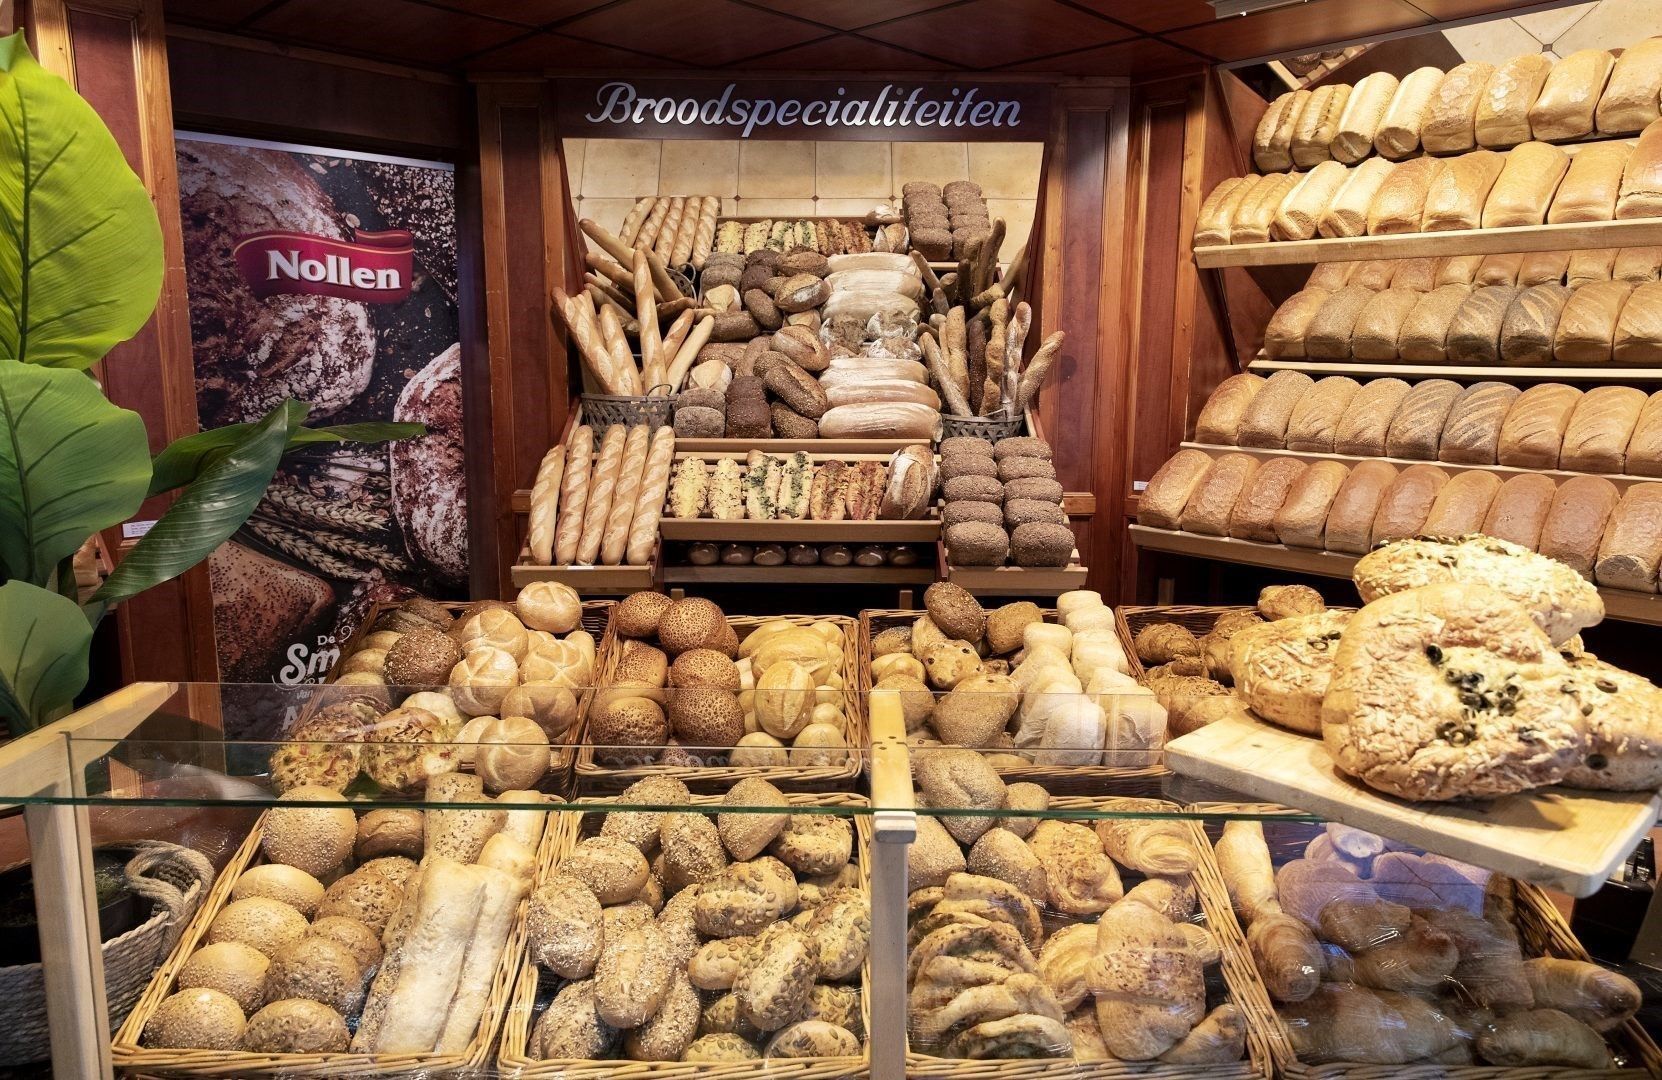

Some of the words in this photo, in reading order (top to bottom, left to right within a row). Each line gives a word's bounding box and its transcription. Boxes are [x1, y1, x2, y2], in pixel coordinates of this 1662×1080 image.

[585, 82, 1021, 137] Broodspecialiteiten
[266, 250, 401, 290] Nollen
[317, 635, 335, 646] De
[279, 643, 340, 685] Sm
